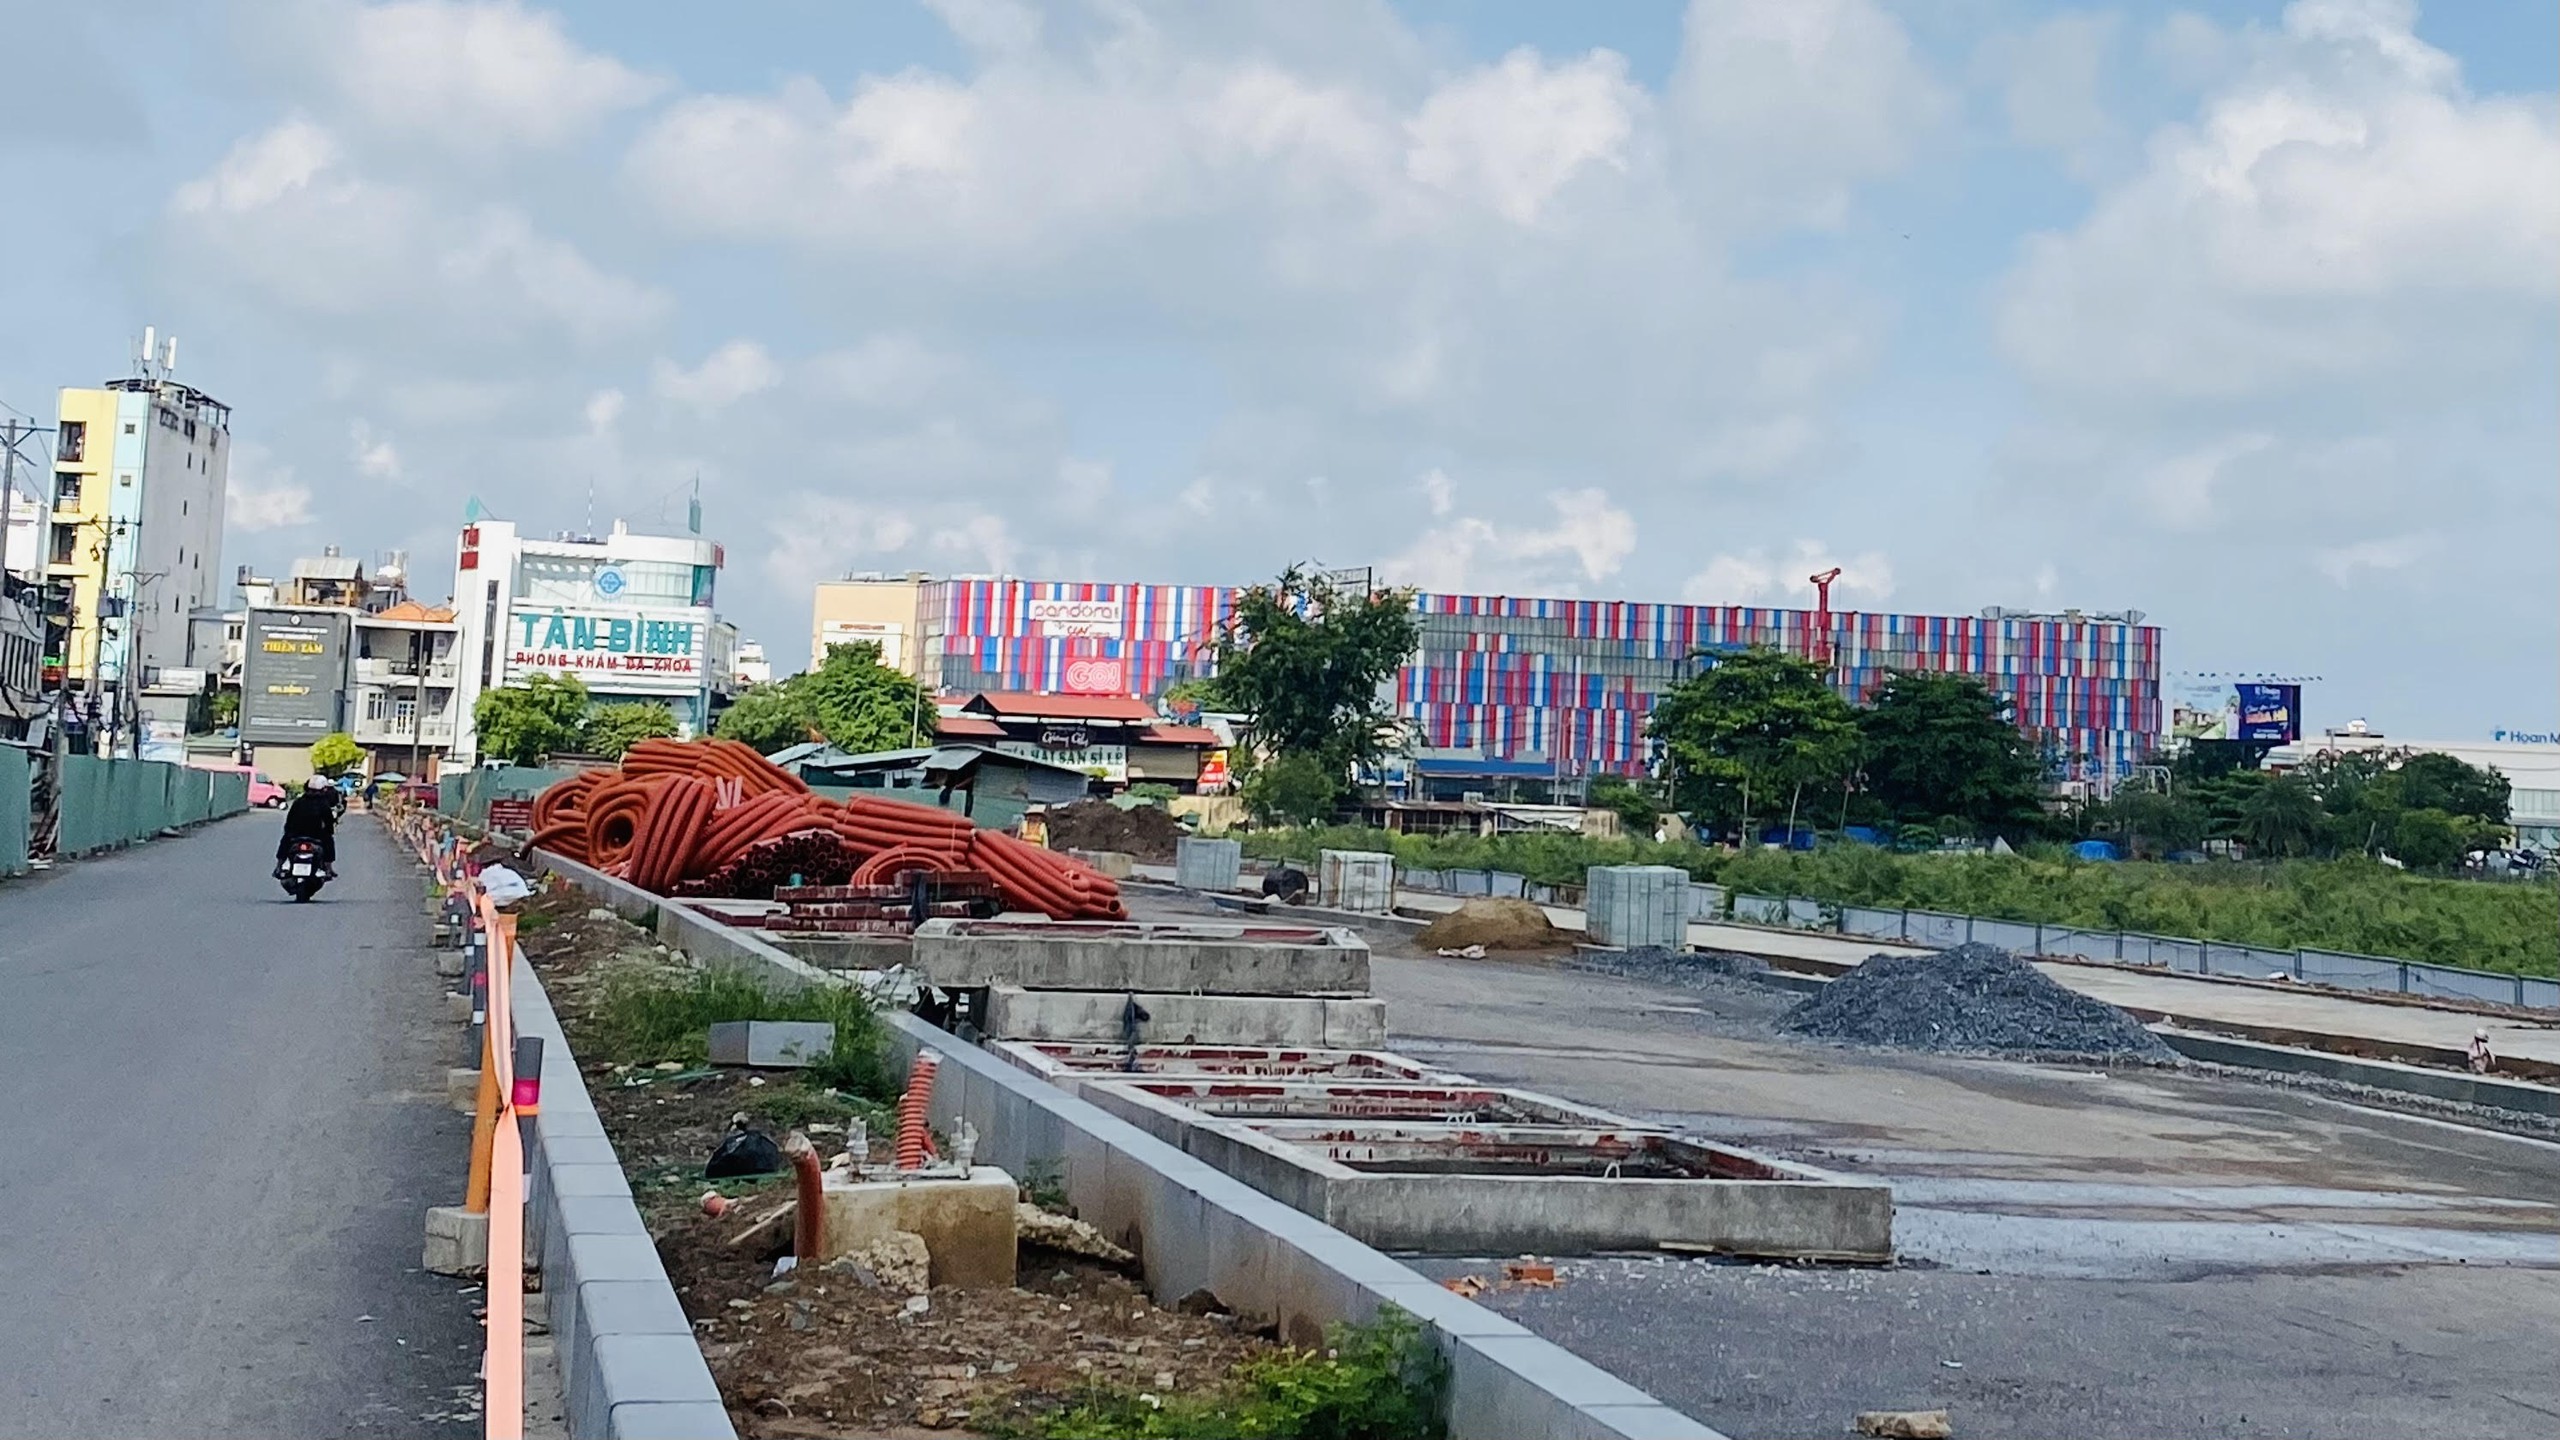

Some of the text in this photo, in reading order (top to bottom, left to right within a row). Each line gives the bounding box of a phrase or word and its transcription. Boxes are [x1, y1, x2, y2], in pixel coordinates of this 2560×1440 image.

[1035, 603, 1112, 618] pandora
[518, 606, 693, 655] TÂN BÌNH
[575, 652, 617, 670] KHÁM
[1067, 661, 1120, 690] GO!
[2510, 730, 2547, 743] Hoan
